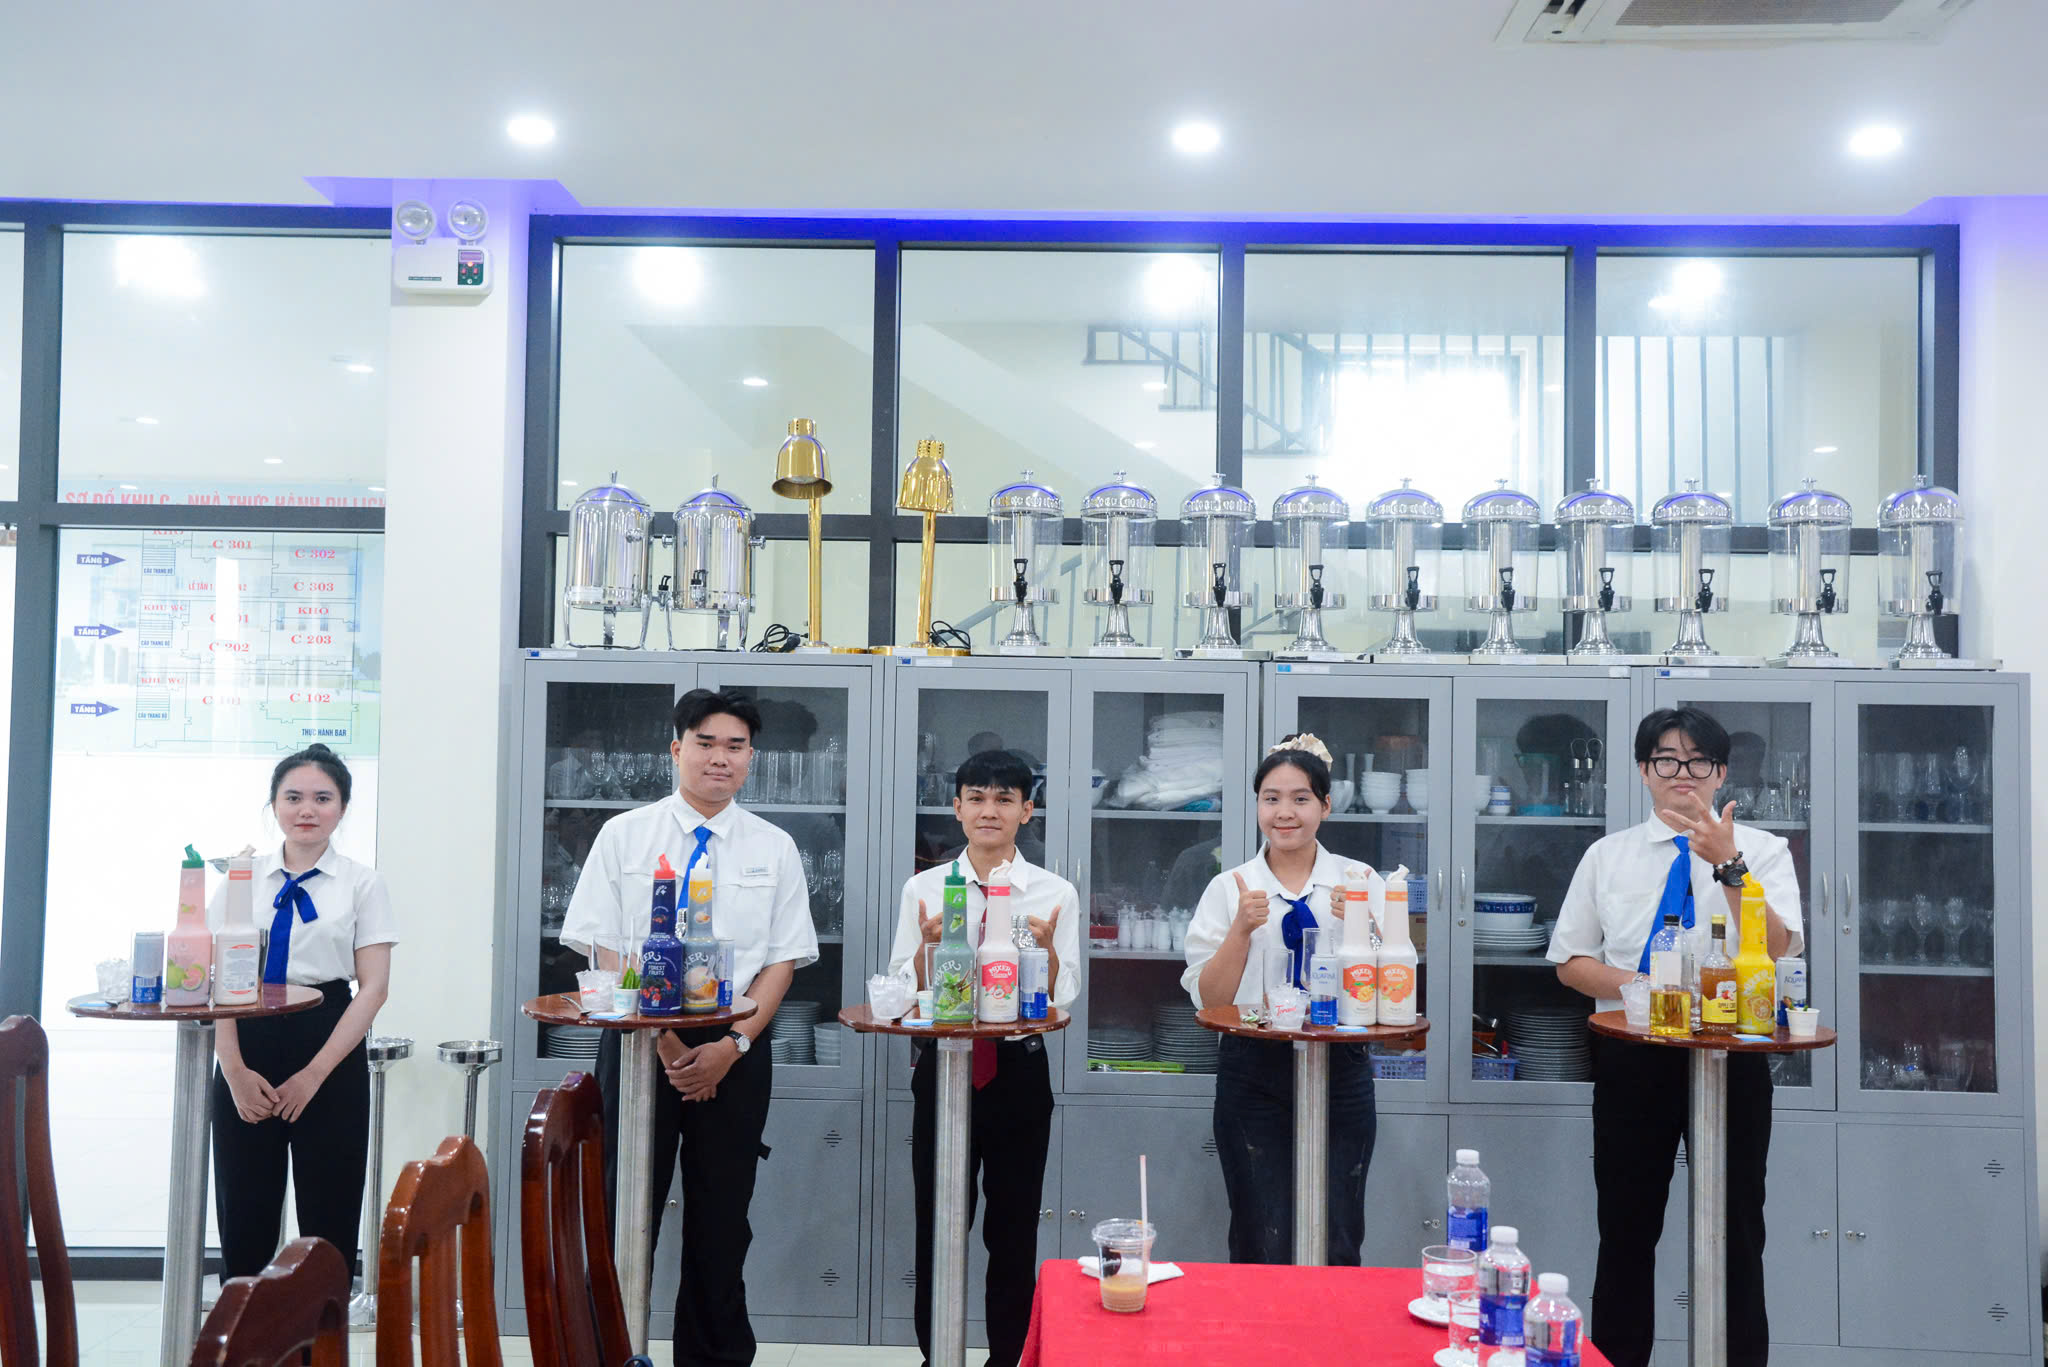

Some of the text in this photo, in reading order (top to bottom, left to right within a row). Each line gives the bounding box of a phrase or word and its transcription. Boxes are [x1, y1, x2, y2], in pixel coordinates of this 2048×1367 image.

[212, 540, 252, 549] C 301
[294, 549, 336, 559] C 302
[293, 582, 334, 592] C 303
[291, 634, 332, 645] C 203
[290, 693, 331, 703] C 102
